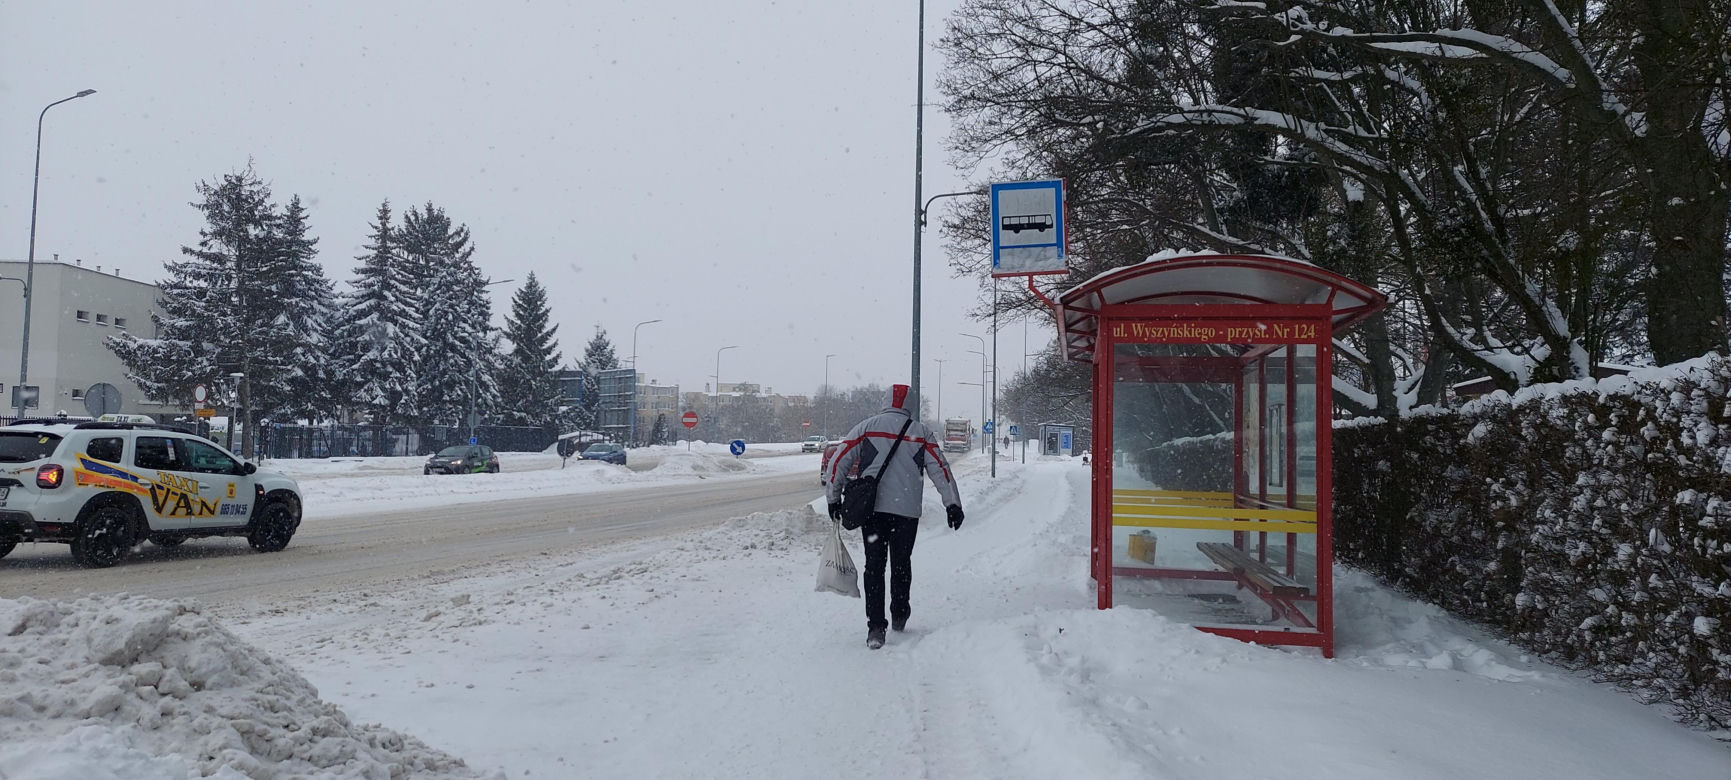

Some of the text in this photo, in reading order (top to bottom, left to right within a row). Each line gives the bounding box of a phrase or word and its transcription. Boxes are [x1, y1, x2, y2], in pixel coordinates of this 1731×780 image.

[1113, 323, 1128, 338] ul.
[1132, 323, 1216, 342] Wyszyńskiego
[1227, 325, 1269, 342] przyst.
[1273, 324, 1290, 339] Nr
[1295, 324, 1316, 339] 124
[157, 471, 199, 495] TAXI
[149, 483, 219, 516] VAN
